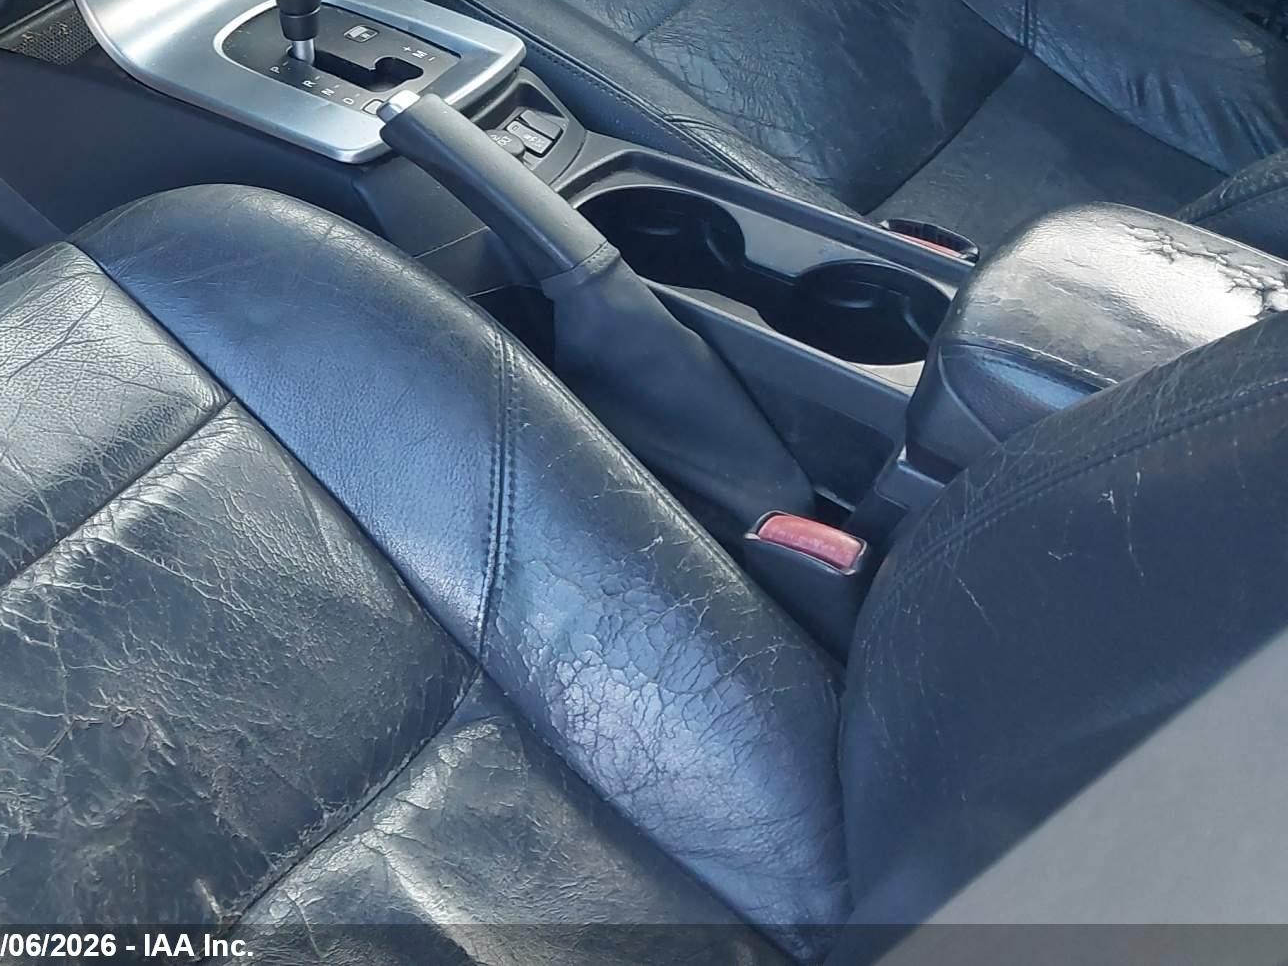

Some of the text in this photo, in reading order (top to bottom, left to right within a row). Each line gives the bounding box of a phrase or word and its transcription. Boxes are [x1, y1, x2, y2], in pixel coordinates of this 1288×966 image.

[269, 65, 281, 74] P
[302, 80, 316, 88] R
[321, 88, 335, 96] N
